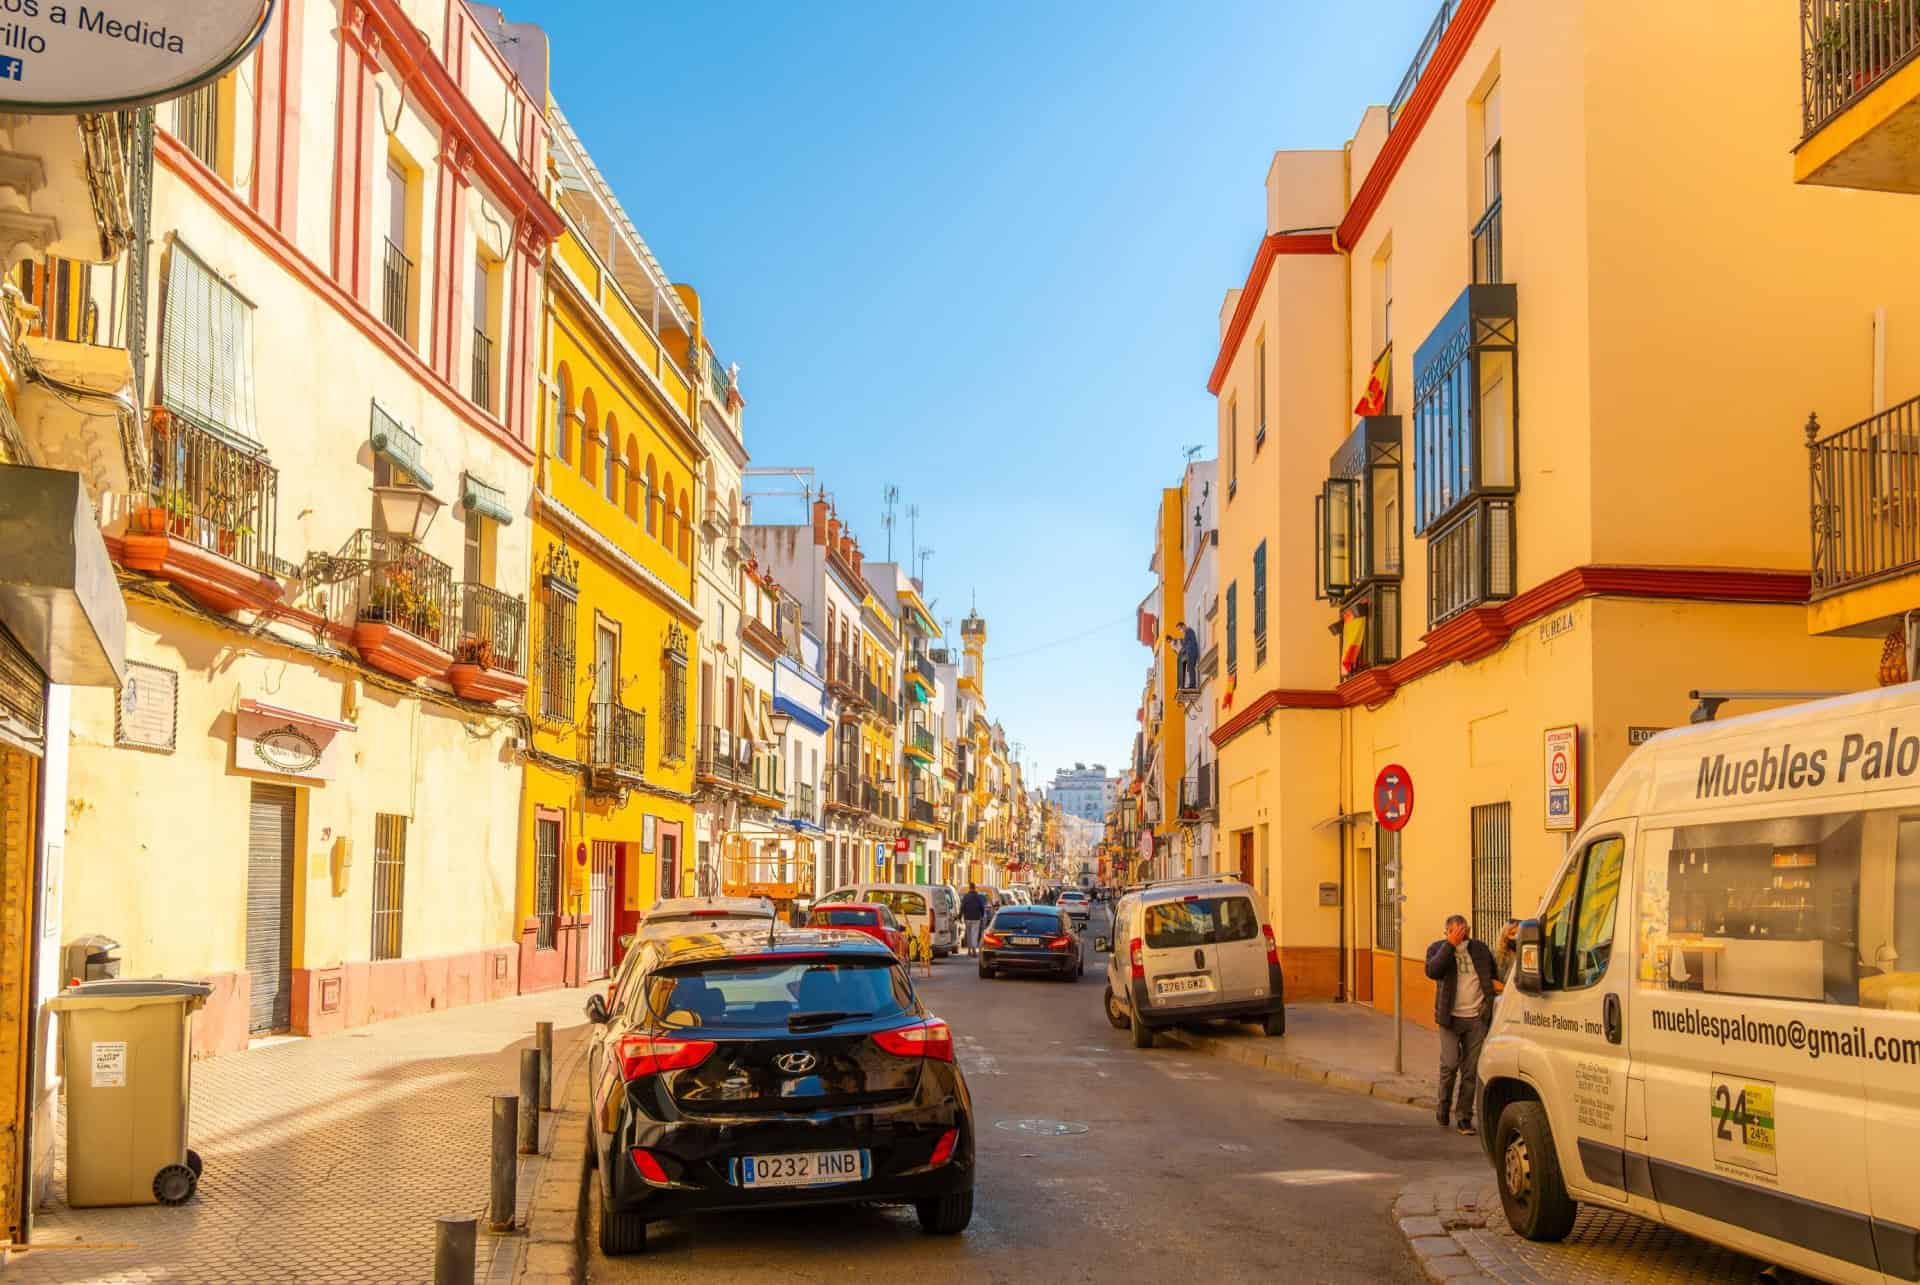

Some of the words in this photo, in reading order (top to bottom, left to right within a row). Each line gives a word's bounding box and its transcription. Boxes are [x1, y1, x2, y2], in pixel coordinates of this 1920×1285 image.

[0, 0, 39, 17] os
[50, 6, 66, 24] a
[78, 6, 184, 54] Medida
[1696, 743, 1828, 799] Muebles
[1837, 727, 1920, 783] Palo
[1524, 1010, 1552, 1028] Muebles
[1552, 1014, 1579, 1033] Palomo
[1652, 1007, 1920, 1064] mueblespalomo@gmail.com
[1716, 1084, 1750, 1145] 24
[757, 1157, 809, 1179] 0232
[817, 1153, 856, 1175] HNB
